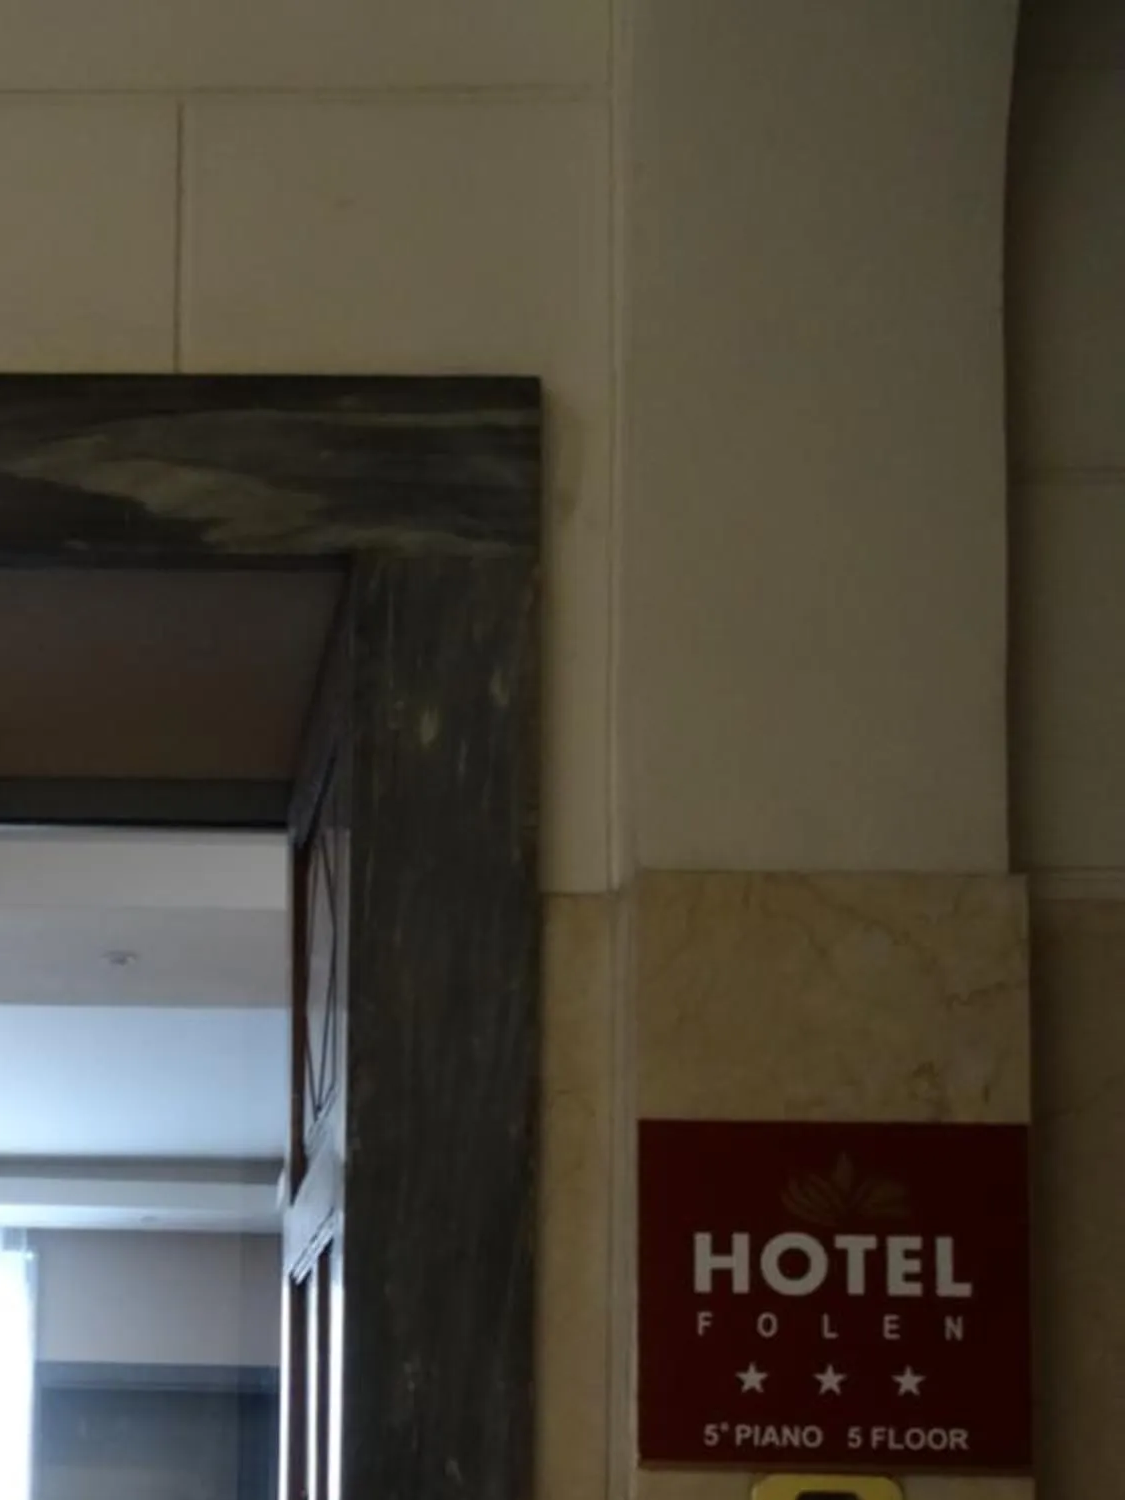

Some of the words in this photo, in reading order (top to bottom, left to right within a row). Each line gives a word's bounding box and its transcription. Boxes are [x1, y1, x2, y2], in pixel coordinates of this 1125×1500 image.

[693, 1231, 972, 1297] HOTEL
[696, 1311, 964, 1341] FOLEN
[734, 1424, 823, 1448] PIANO
[847, 1427, 863, 1449] 5
[871, 1428, 970, 1451] FLOOR
